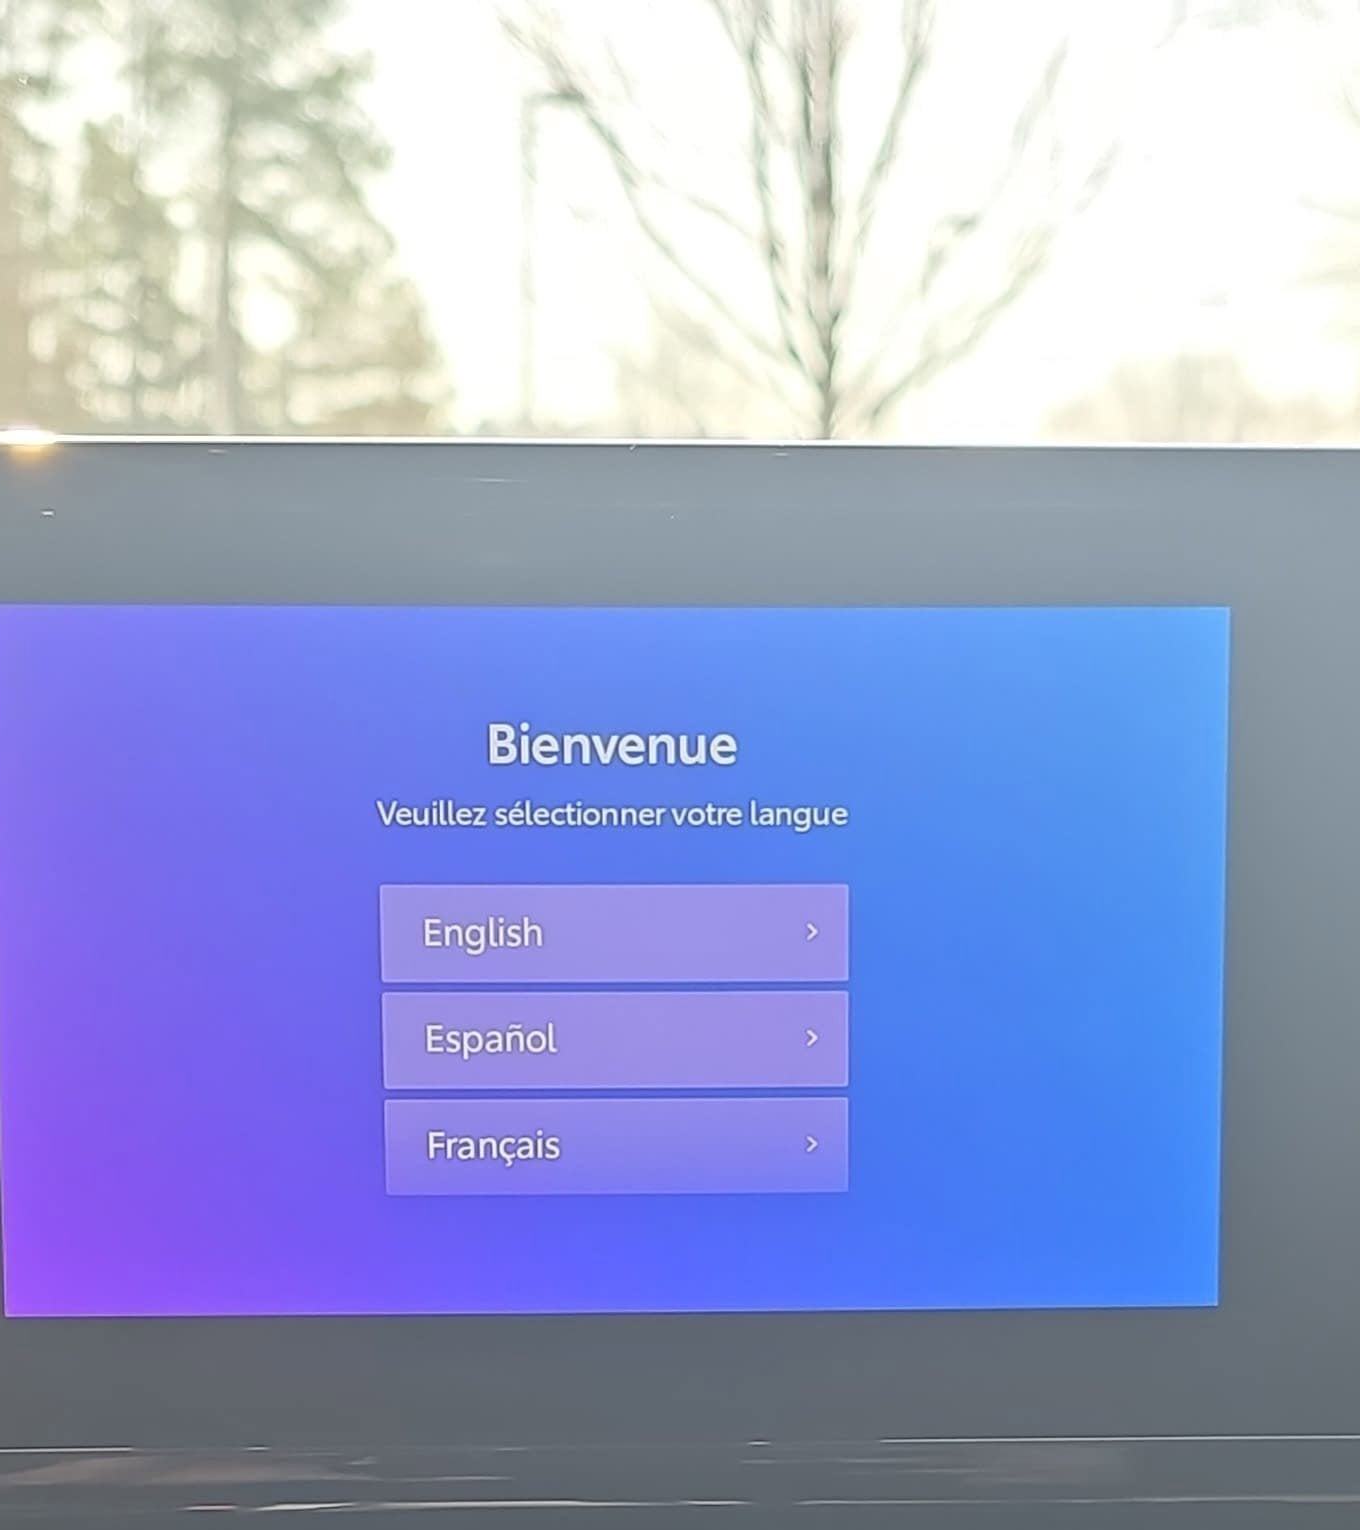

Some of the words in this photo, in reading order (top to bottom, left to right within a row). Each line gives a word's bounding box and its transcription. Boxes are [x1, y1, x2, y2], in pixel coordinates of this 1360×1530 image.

[487, 722, 738, 766] Bienvenue
[376, 799, 488, 828] Veuillez
[494, 798, 667, 828] sélectionner
[671, 802, 744, 828] votre
[749, 799, 850, 834] langue
[423, 916, 543, 956] English
[425, 1020, 558, 1061] Español
[427, 1128, 561, 1171] Français
